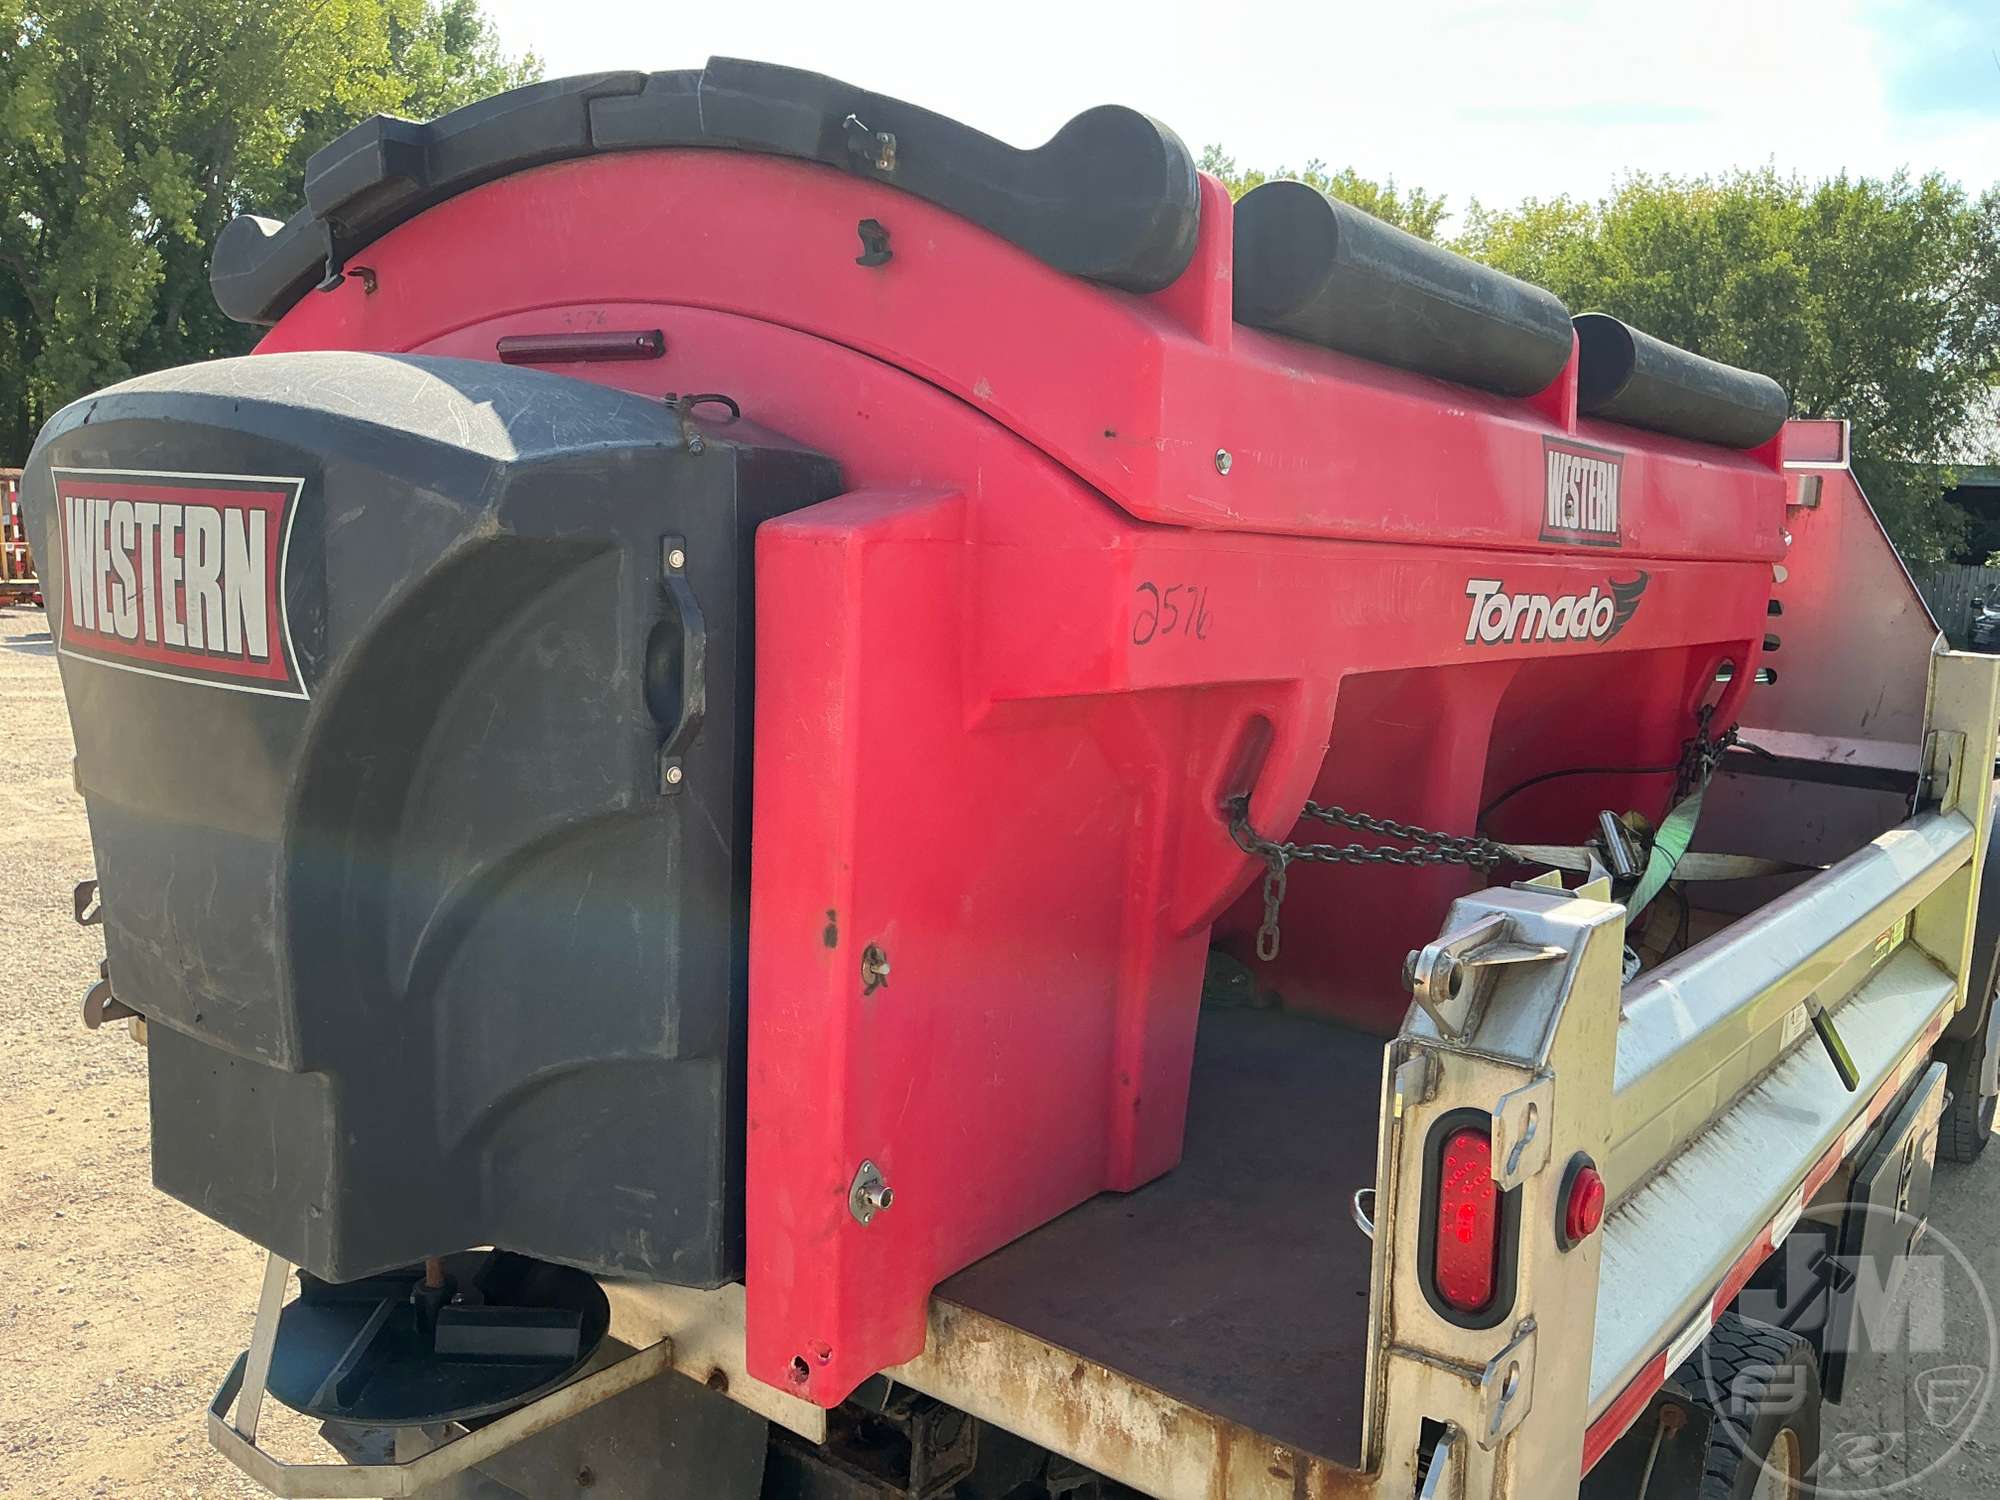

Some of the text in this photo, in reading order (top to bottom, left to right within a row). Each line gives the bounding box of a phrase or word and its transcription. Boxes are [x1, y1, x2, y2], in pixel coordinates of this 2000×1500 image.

[1548, 450, 1618, 532] WESTERN
[65, 496, 268, 657] WESTERN
[1465, 579, 1615, 643] Tornado
[1133, 582, 1213, 645] 2576
